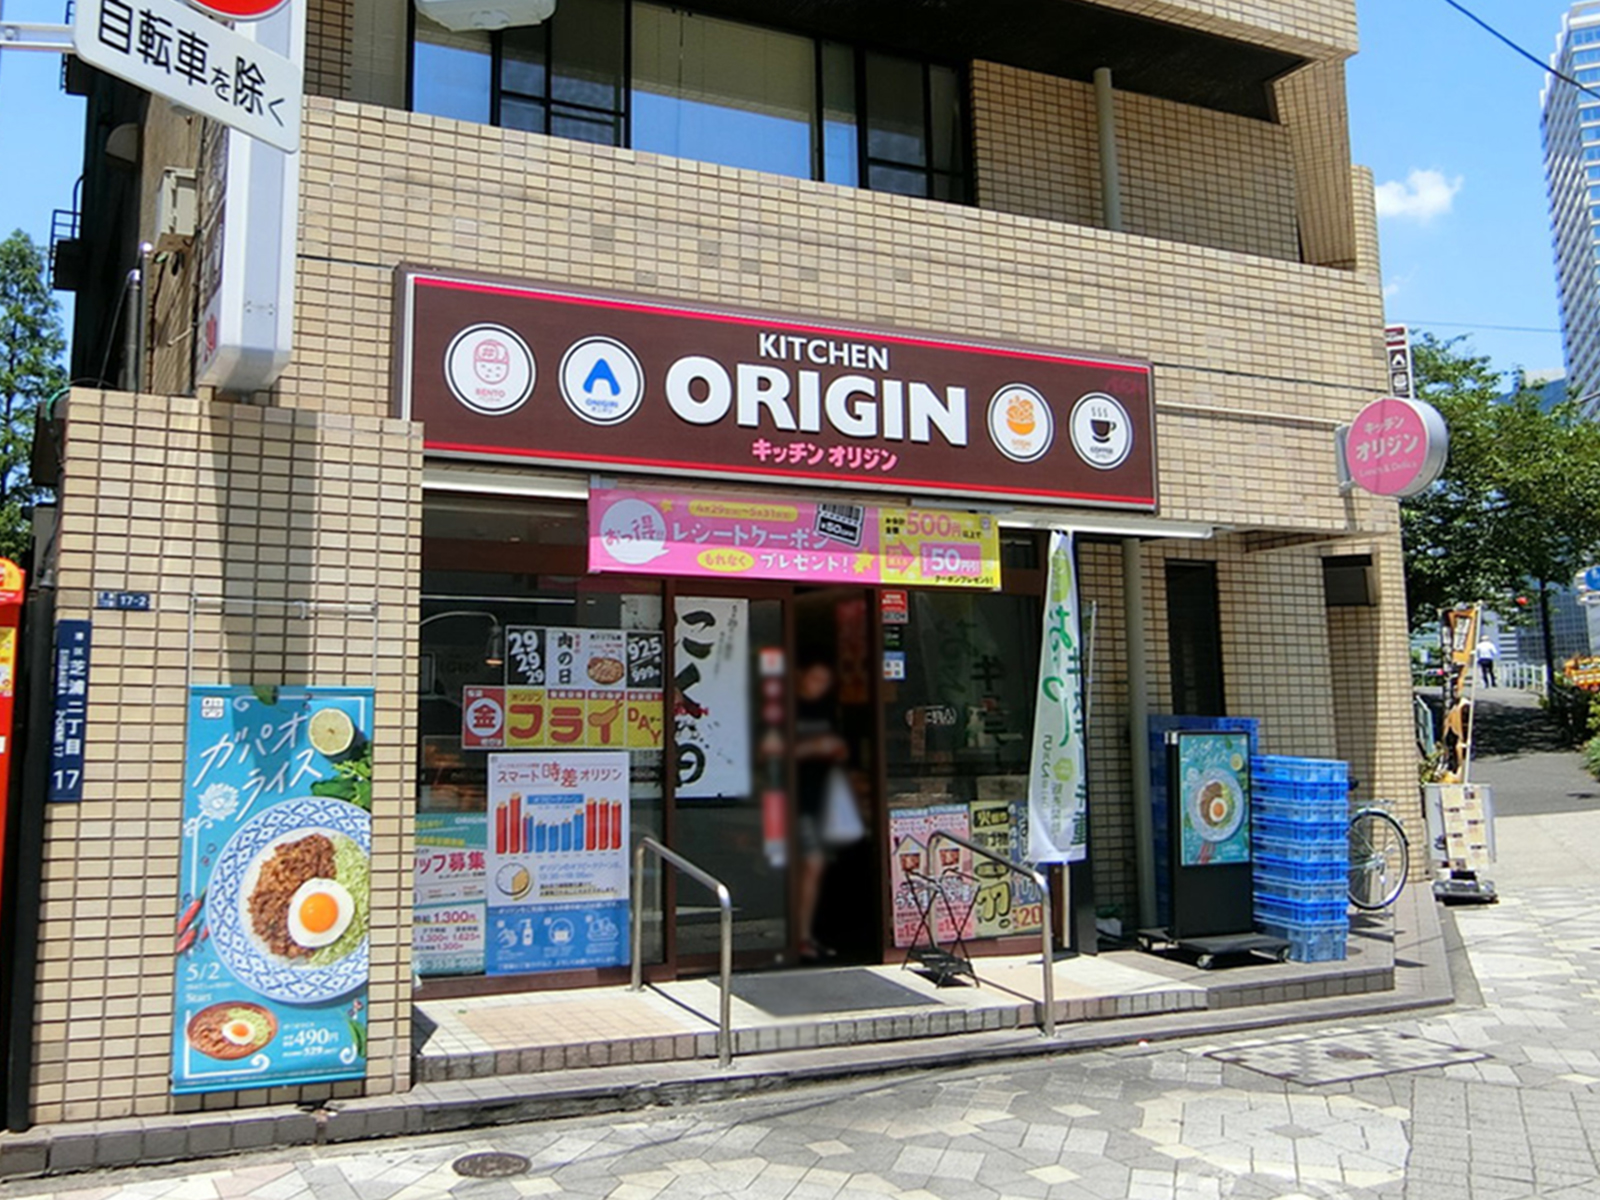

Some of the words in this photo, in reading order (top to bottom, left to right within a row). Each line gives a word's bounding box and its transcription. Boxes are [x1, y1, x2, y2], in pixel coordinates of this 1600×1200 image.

[98, 0, 286, 127] 自転車を除く
[759, 332, 889, 371] KITCHEN
[665, 355, 968, 447] ORIGIN
[752, 438, 825, 466] キッチン
[828, 444, 898, 472] オリジン
[1356, 434, 1420, 462] オリジン
[673, 522, 830, 549] レシートクーポン
[704, 553, 747, 568] もれなく
[760, 553, 848, 574] プレゼント!
[120, 595, 147, 607] 17-2
[508, 630, 539, 656] 29
[627, 636, 662, 661] 925
[516, 652, 541, 673] 29
[557, 632, 574, 684] 肉の日
[525, 669, 545, 684] 29
[473, 704, 497, 728] 金
[192, 712, 308, 788] ガパオ
[53, 769, 80, 790] 17
[235, 748, 323, 822] ライス
[414, 851, 486, 875] ッフ募集
[186, 962, 221, 982] 5/2
